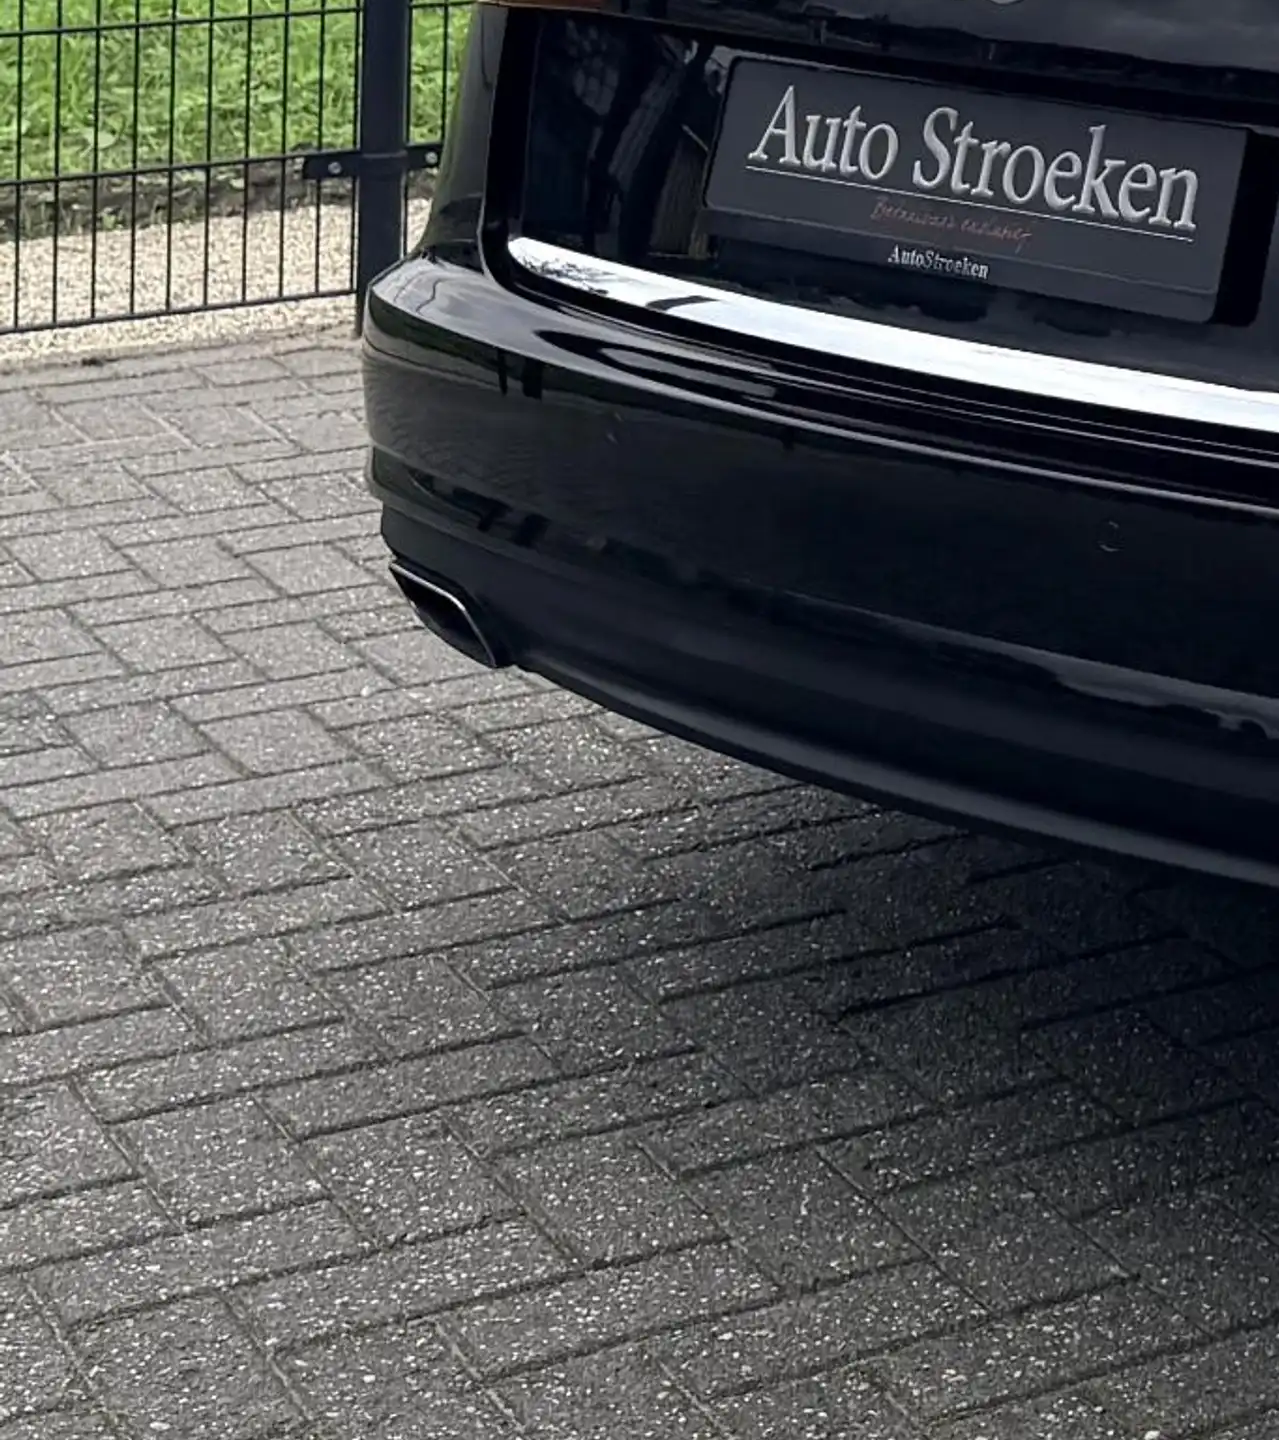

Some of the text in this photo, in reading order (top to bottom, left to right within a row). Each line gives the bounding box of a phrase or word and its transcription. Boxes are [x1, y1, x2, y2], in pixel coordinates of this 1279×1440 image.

[747, 85, 1199, 231] Auto Stroeken
[888, 244, 989, 280] AutoStroeken
